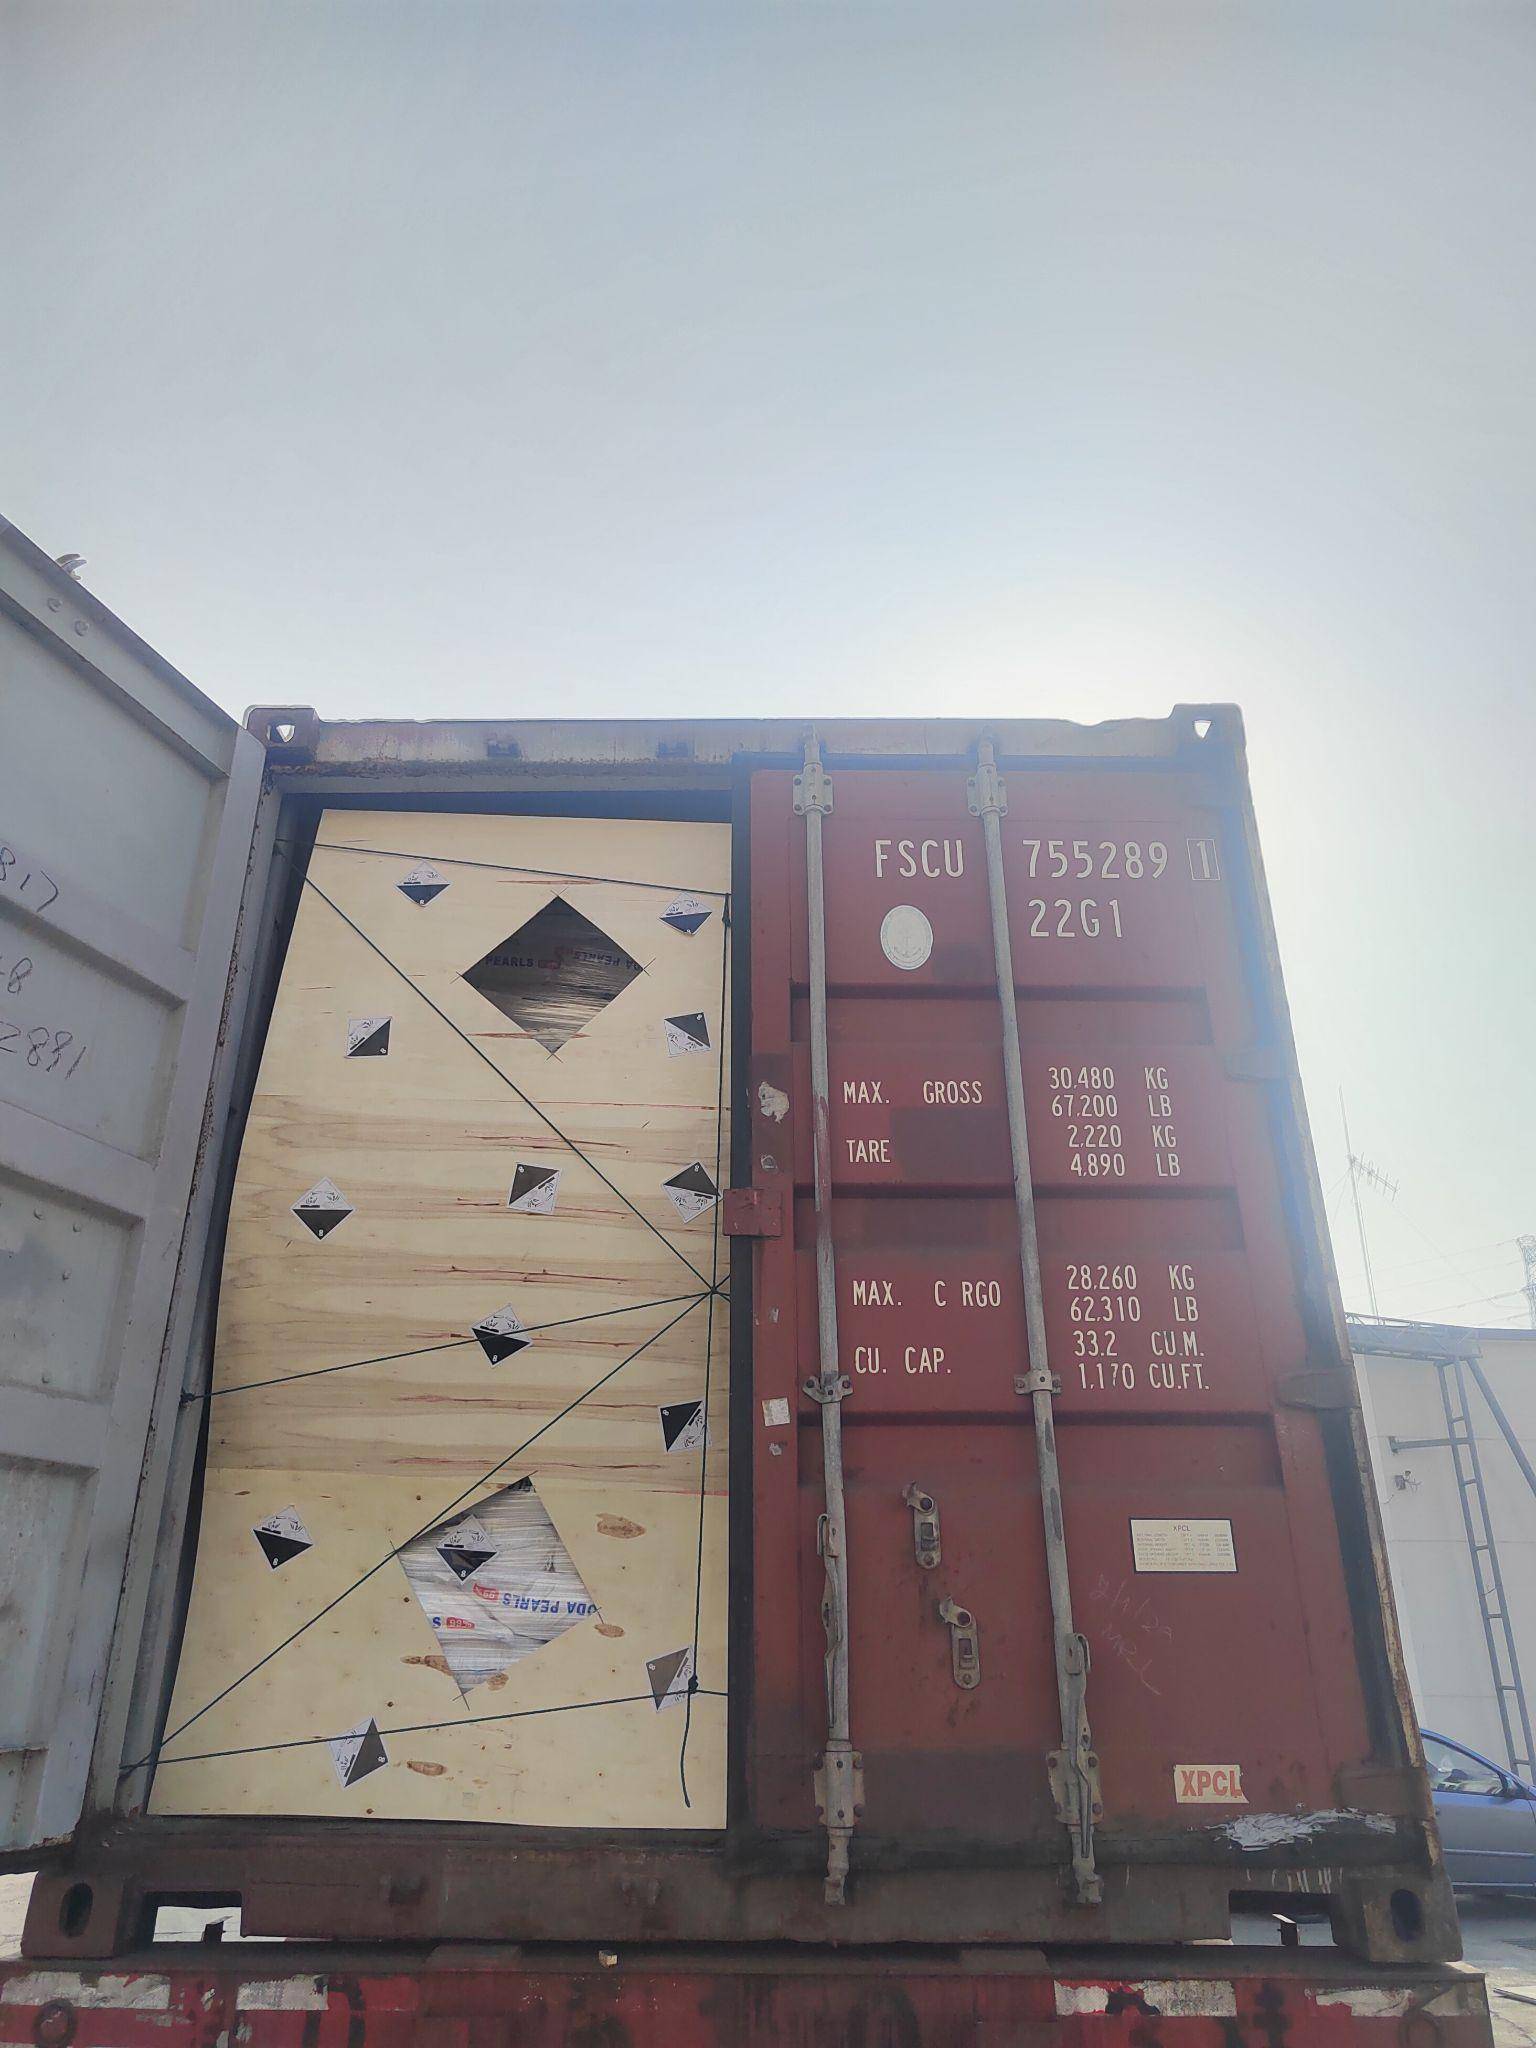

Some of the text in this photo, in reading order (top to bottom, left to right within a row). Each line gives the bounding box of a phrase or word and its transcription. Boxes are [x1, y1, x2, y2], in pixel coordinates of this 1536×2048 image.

[876, 840, 1211, 878] FSCU 755289 1
[1029, 899, 1121, 937] 22G1
[1049, 1067, 1169, 1089] 30,480 KG
[844, 1081, 983, 1104] MAX. GROSS
[1052, 1095, 1172, 1117] 67,200 LB
[1067, 1125, 1177, 1148] 2,220 KG
[847, 1140, 891, 1163] TARE
[1070, 1154, 1181, 1177] 4,890 LB
[1066, 1265, 1195, 1290] 28,260 KG
[853, 1281, 1001, 1307] MAX. CRGO
[1070, 1296, 1199, 1322] 62,310 LB
[1073, 1331, 1205, 1356] 33.2 CU.M.
[855, 1347, 951, 1374] CU. CAP.
[1078, 1363, 1210, 1390] 1,170 CU.FT.
[502, 1592, 560, 1614] PEARLS
[1181, 1769, 1243, 1798] XPCL
